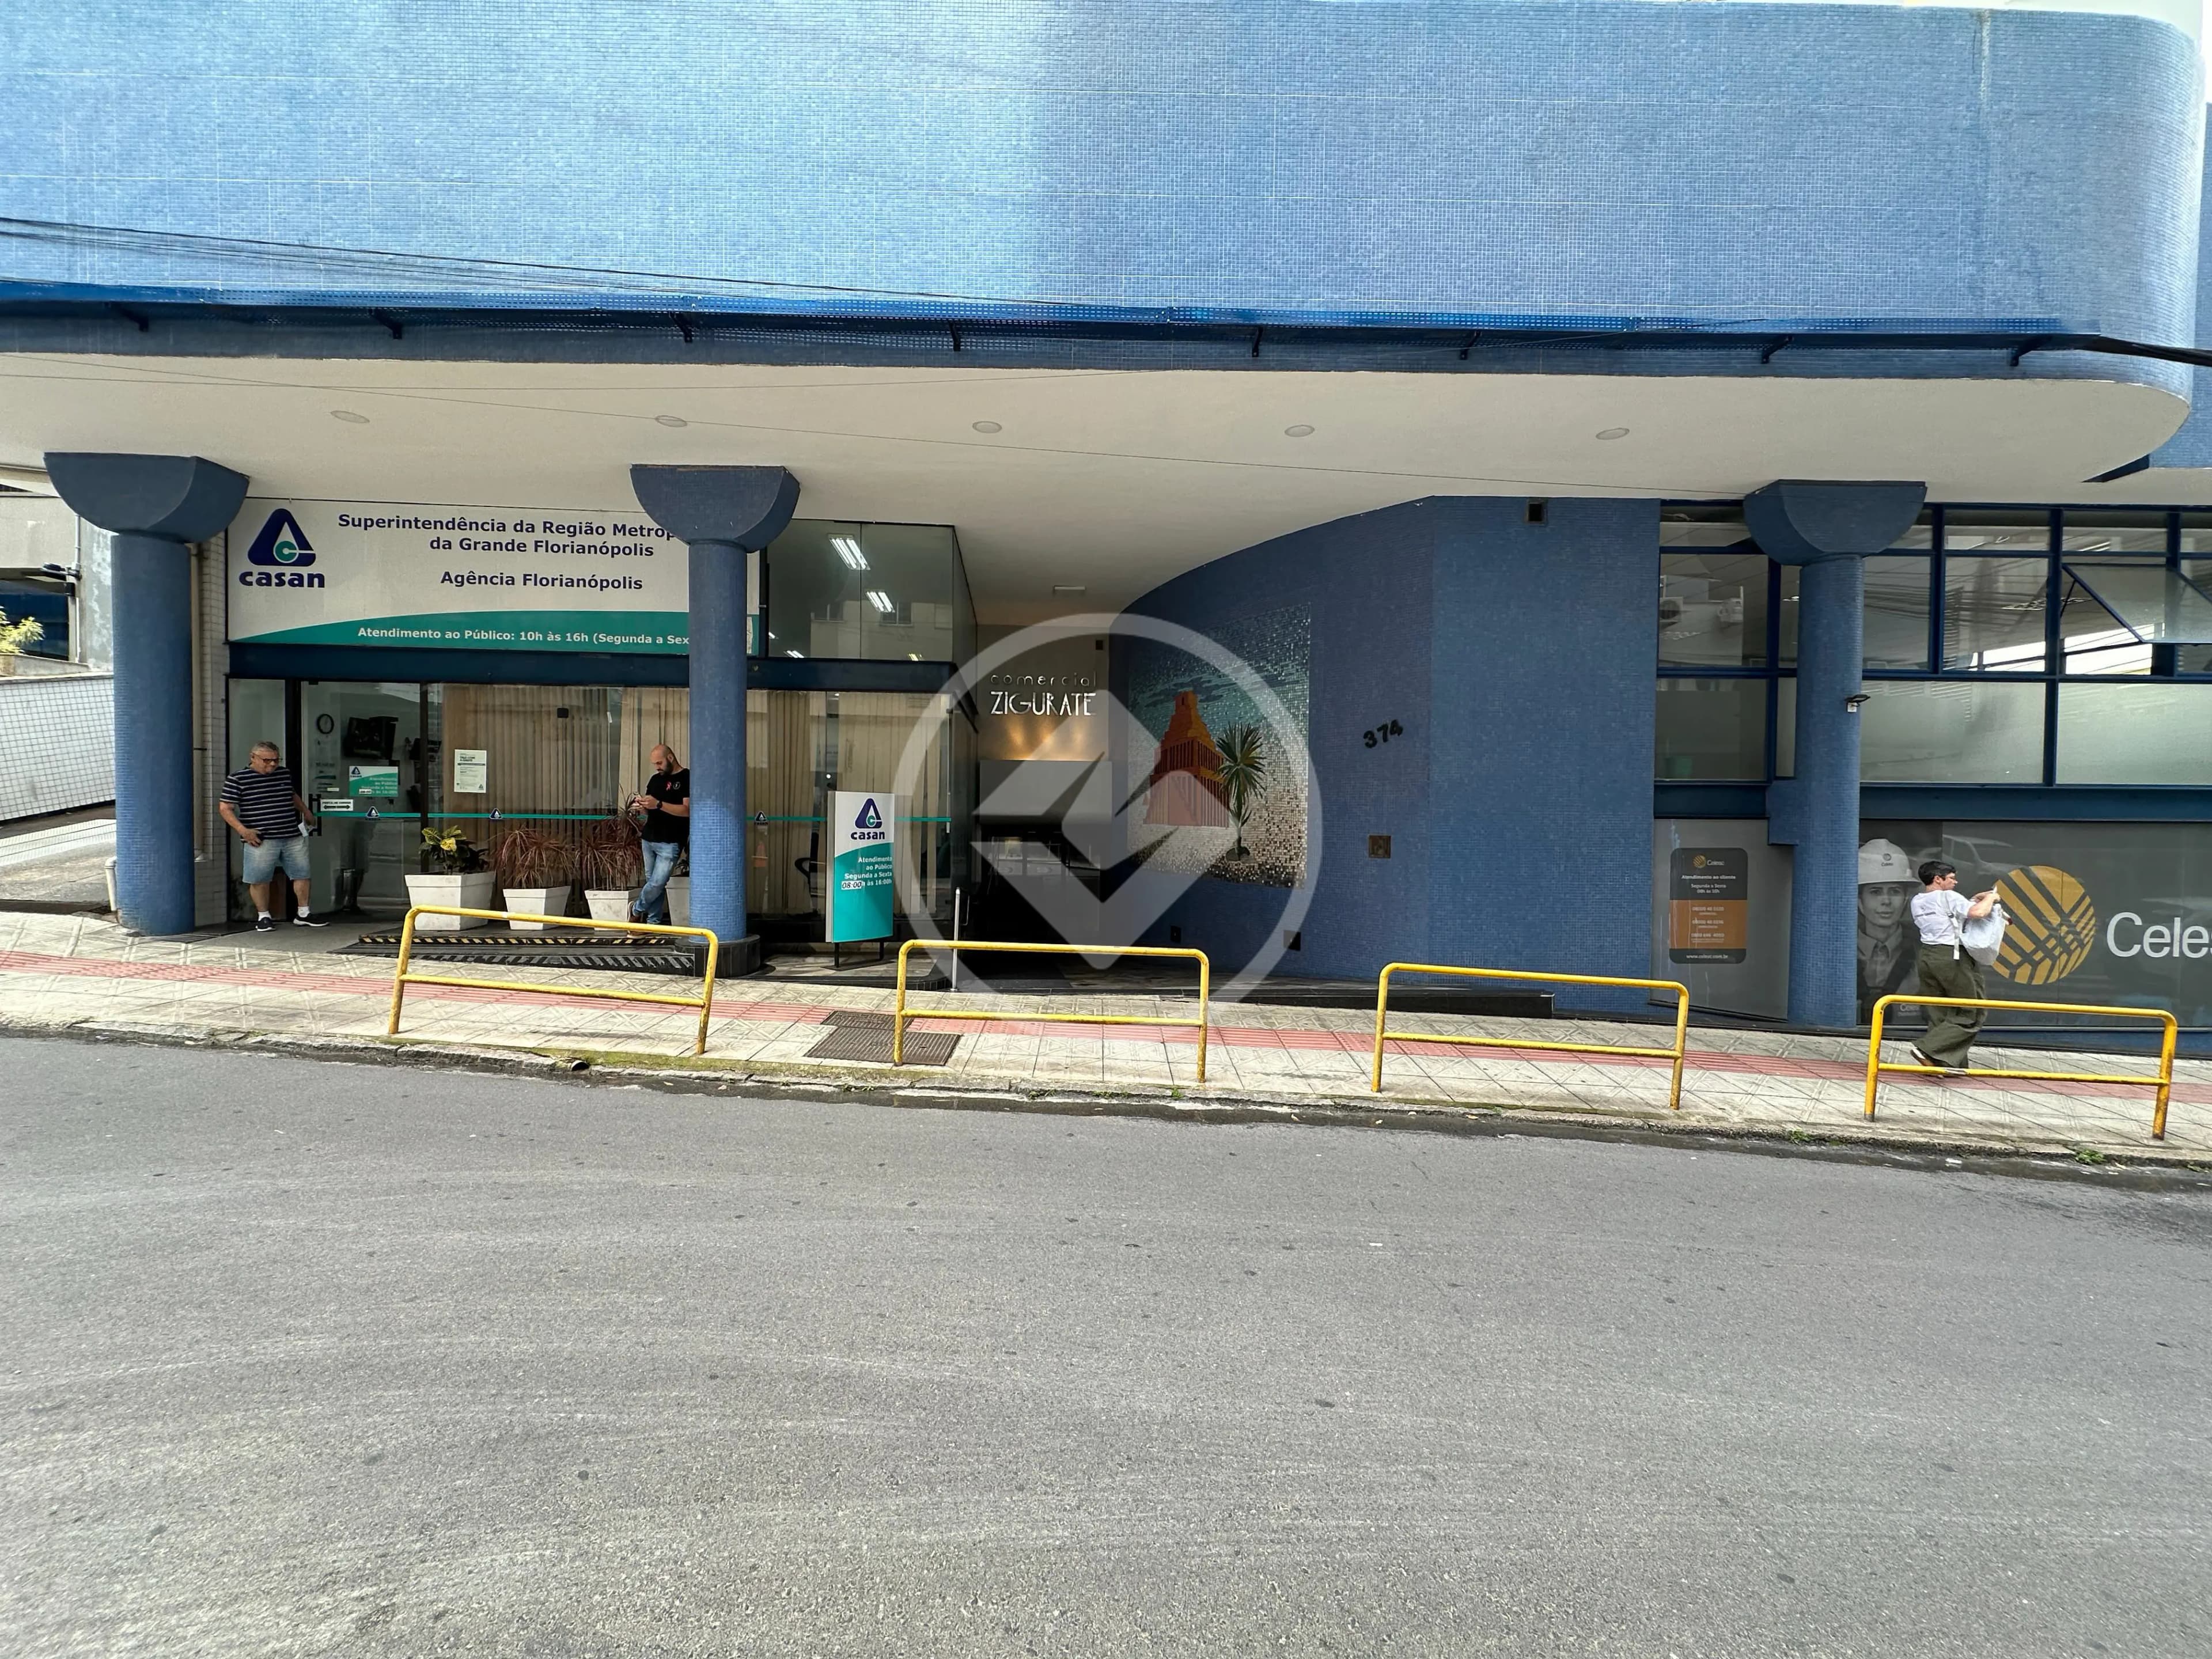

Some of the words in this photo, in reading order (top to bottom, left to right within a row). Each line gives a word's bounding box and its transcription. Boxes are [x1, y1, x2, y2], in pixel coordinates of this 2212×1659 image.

[338, 514, 506, 532] Superintendência
[513, 520, 535, 533] da
[543, 521, 605, 537] Região
[430, 536, 452, 550] da
[459, 538, 527, 552] Grande
[534, 540, 654, 558] Florianópolis
[239, 571, 325, 588] casan
[441, 570, 516, 587] Agência
[522, 574, 643, 591] Florianópolis
[358, 627, 441, 639] Atendimento
[445, 630, 460, 639] ao
[464, 628, 515, 640] Público:
[520, 632, 543, 641] 10h
[547, 631, 561, 641] às
[566, 633, 589, 642] 16h
[593, 634, 652, 645] (Segunda
[656, 636, 663, 644] a
[990, 671, 1097, 687] comercial
[990, 691, 1097, 716] ZIGURATE
[1363, 719, 1403, 748] 374
[850, 831, 885, 840] casan
[2107, 912, 2212, 959] Cele
